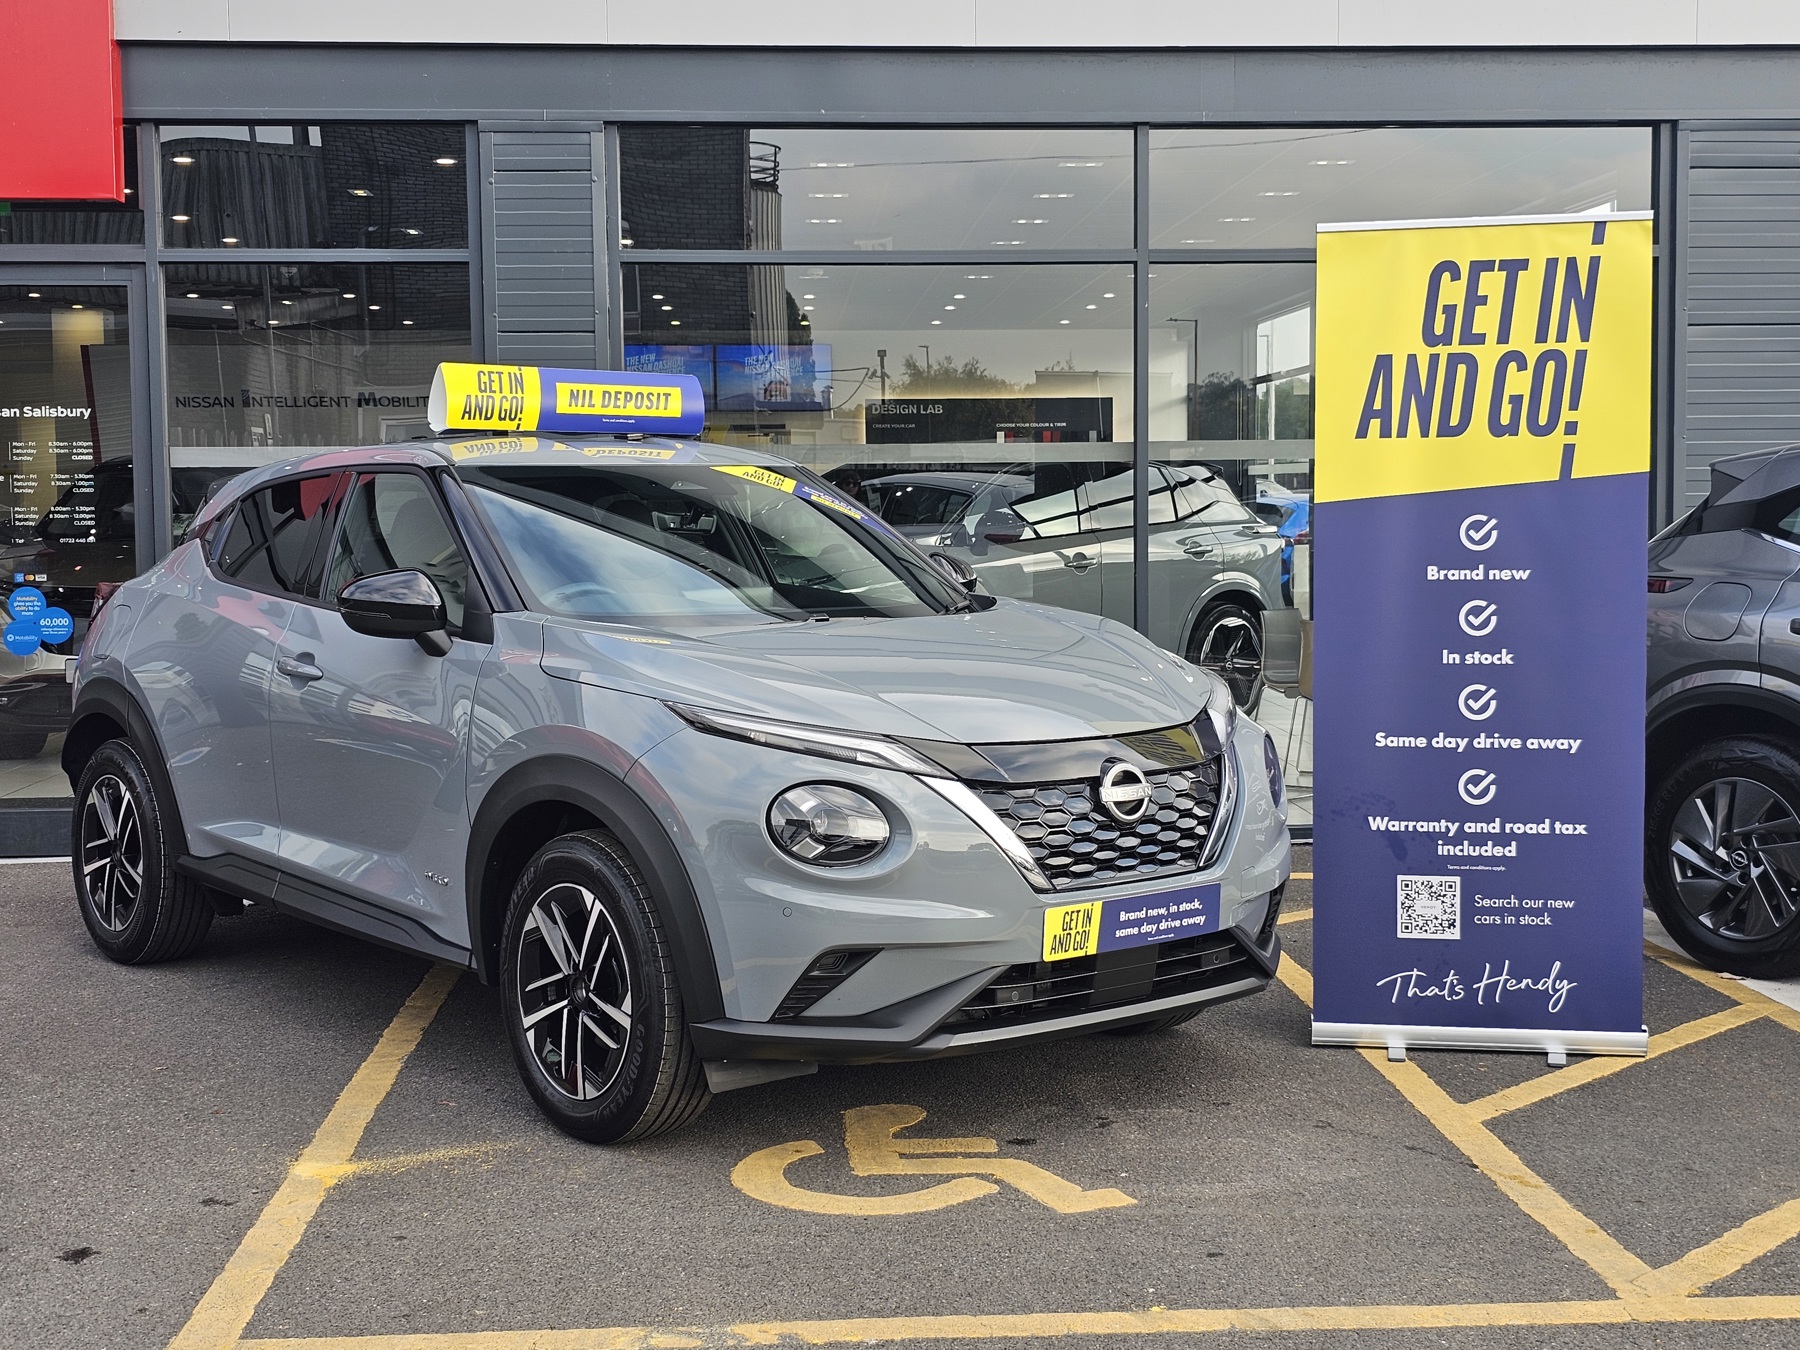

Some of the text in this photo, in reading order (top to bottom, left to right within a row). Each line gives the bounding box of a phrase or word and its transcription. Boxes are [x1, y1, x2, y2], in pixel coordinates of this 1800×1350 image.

[1421, 256, 1601, 348] GET IN
[477, 370, 524, 394] GET IN
[176, 396, 235, 408] NISSAN
[568, 389, 671, 410] NIL DEPOSIT
[1355, 349, 1587, 439] AND GO!
[23, 405, 91, 419] Salisbury
[461, 395, 524, 422] AND GO!
[871, 404, 943, 414] DESIGN LAB
[1426, 564, 1531, 581] Brand new
[40, 618, 69, 626] 60,000
[1442, 648, 1514, 665] In stock
[1375, 731, 1582, 753] Same day drive away
[1103, 786, 1151, 800] NISSAN
[1368, 816, 1588, 836] Warranty and road tax
[1437, 839, 1517, 857] included
[1120, 898, 1203, 922] Brand new, in stock,
[1474, 895, 1575, 909] Search our new
[1062, 907, 1094, 932] GET IN
[1115, 926, 1138, 938] same
[1140, 922, 1158, 936] day
[1159, 918, 1181, 931] drive
[1182, 914, 1206, 927] away
[1474, 912, 1552, 926] cars in stock
[1050, 930, 1090, 955] AND GO!
[1376, 959, 1577, 1013] That's Hendy
